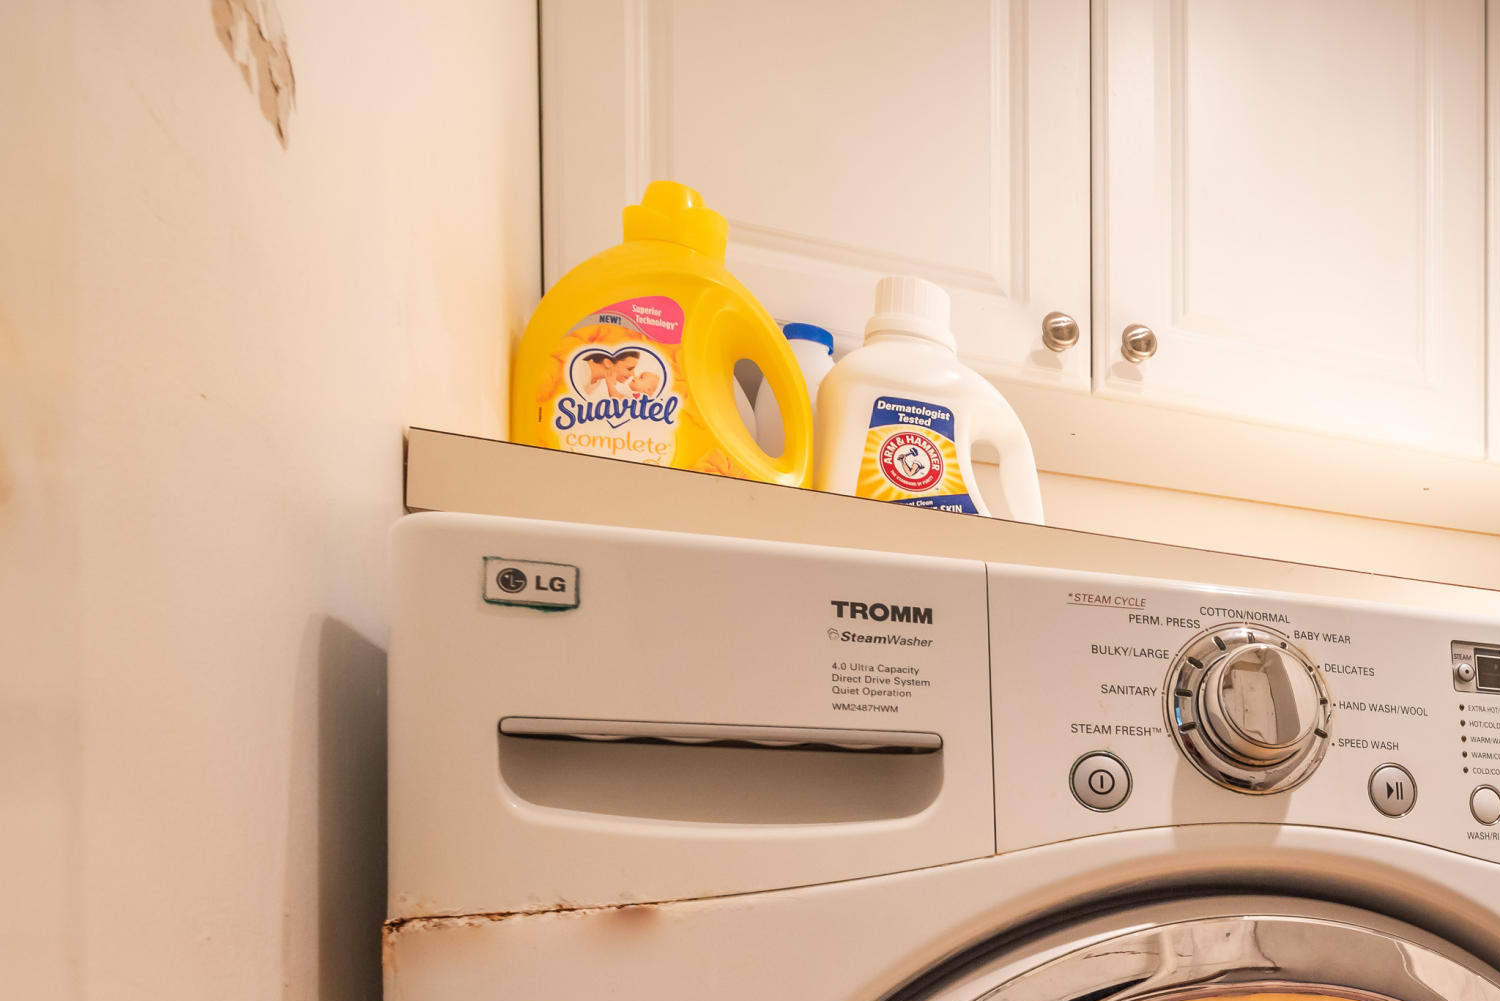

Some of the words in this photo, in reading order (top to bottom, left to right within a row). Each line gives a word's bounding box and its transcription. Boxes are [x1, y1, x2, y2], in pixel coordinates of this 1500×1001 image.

[631, 304, 662, 317] Superior
[599, 314, 622, 326] NEW!
[555, 394, 678, 430] Suavitel
[877, 400, 951, 421] Dermatologist
[897, 413, 932, 427] Tested
[565, 431, 668, 456] complete
[883, 441, 898, 466] ARM
[895, 436, 905, 447] &
[905, 435, 940, 472] HAMMER
[535, 575, 567, 592] LG
[1114, 596, 1147, 608] CYCLE
[830, 600, 933, 624] TROMM
[1199, 606, 1291, 624] COTTON/NORMAL
[1128, 613, 1163, 626] PERM.
[1166, 617, 1201, 629] PRESS
[840, 631, 935, 647] SteamWasher
[1293, 630, 1320, 641] BABY
[1322, 633, 1351, 644] WEAR
[1091, 644, 1170, 660] BULKY/LARGE
[832, 662, 847, 671] 4.0
[849, 663, 875, 672] Ultra
[877, 664, 920, 676] Capacity
[1324, 663, 1375, 677] DELICATES
[832, 673, 861, 684] Direct
[864, 676, 891, 685] Drive
[893, 677, 931, 688] System
[832, 686, 859, 696] Quiet
[862, 687, 912, 698] Operation
[1100, 684, 1157, 697] SANITARY
[1338, 700, 1367, 712] HAND
[1368, 703, 1429, 717] WASH/WOOL
[1467, 705, 1486, 713] EXTRA
[1070, 723, 1112, 735] STEAM
[1469, 721, 1500, 730] HOT/COLD
[1338, 738, 1369, 749] SPEED
[1370, 740, 1399, 751] WASH
